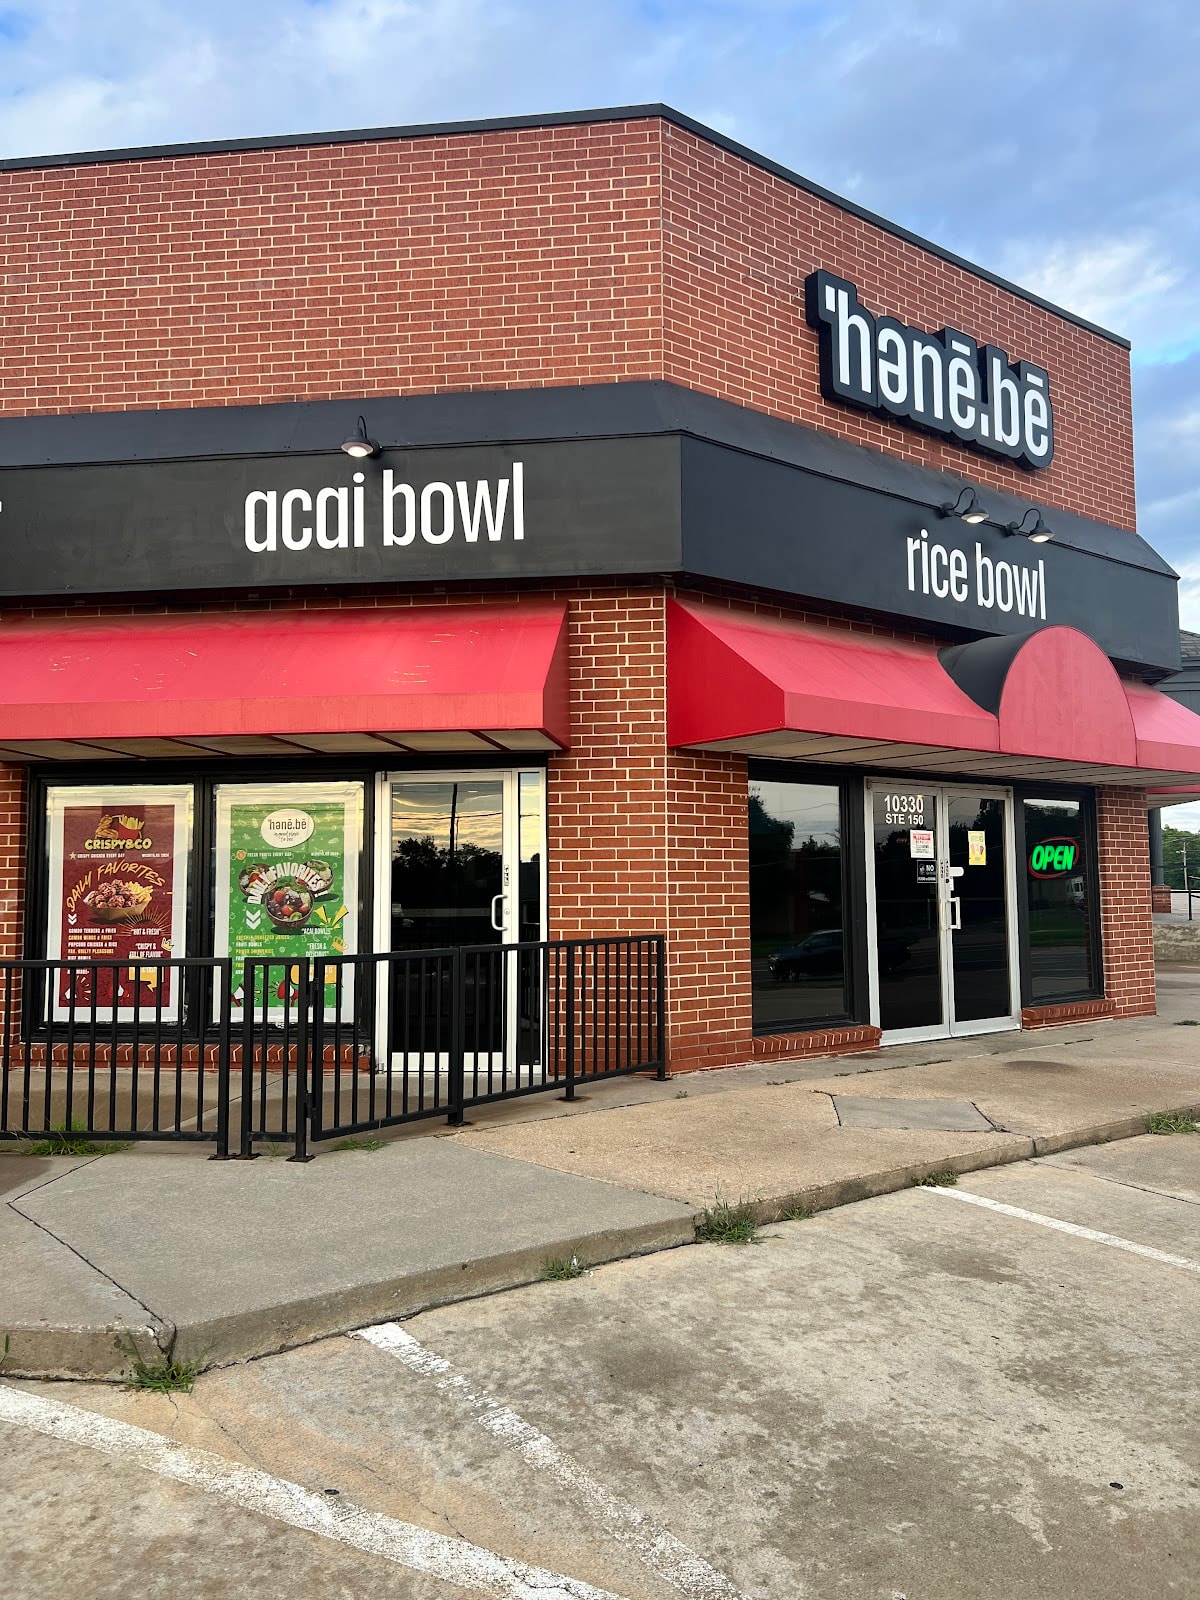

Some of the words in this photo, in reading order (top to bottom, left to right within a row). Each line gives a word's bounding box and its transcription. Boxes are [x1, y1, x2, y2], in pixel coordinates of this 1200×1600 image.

[244, 472, 365, 553] acai
[382, 462, 524, 547] bowl
[906, 529, 968, 602] rice
[976, 542, 1047, 620] bowl
[884, 794, 924, 813] 10330
[885, 813, 905, 824] STE
[908, 814, 924, 825] 150
[84, 838, 152, 850] CRISPY&CO
[1031, 845, 1075, 870] OPEN
[66, 871, 93, 912] DAILY
[97, 859, 166, 887] FAVORITES
